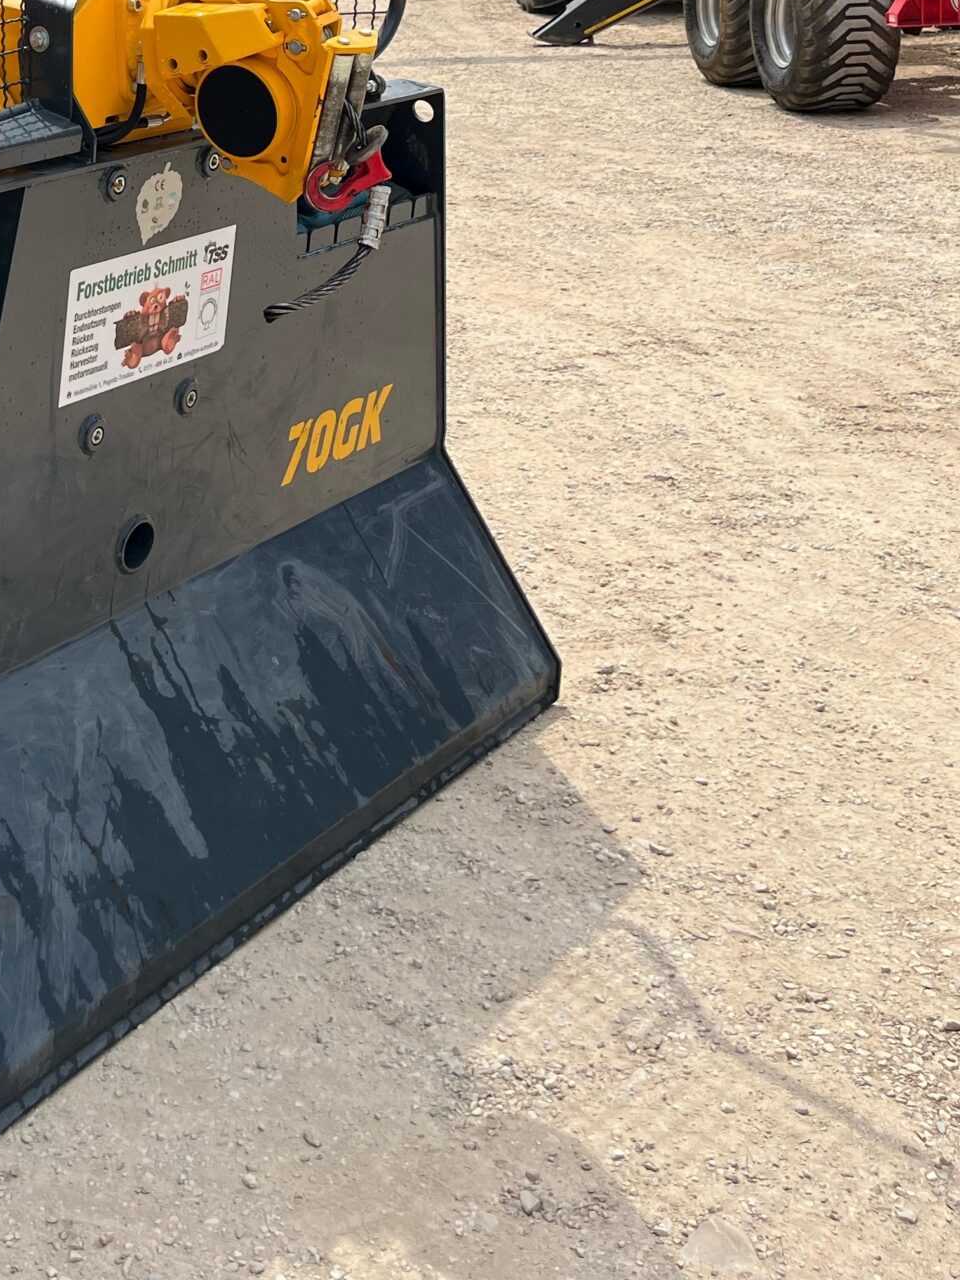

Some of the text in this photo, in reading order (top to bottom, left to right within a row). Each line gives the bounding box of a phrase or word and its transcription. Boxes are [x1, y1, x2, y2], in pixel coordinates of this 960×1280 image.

[208, 244, 229, 264] TSS
[77, 249, 198, 301] Forstbetrieb Schmitt
[202, 271, 220, 288] RAL
[74, 302, 121, 322] Durchforstungen
[73, 318, 106, 334] Endnutzung
[72, 333, 94, 346] Rücken
[71, 343, 98, 358] Rückezug
[68, 360, 108, 382] motormanuell
[70, 355, 98, 370] Harvester
